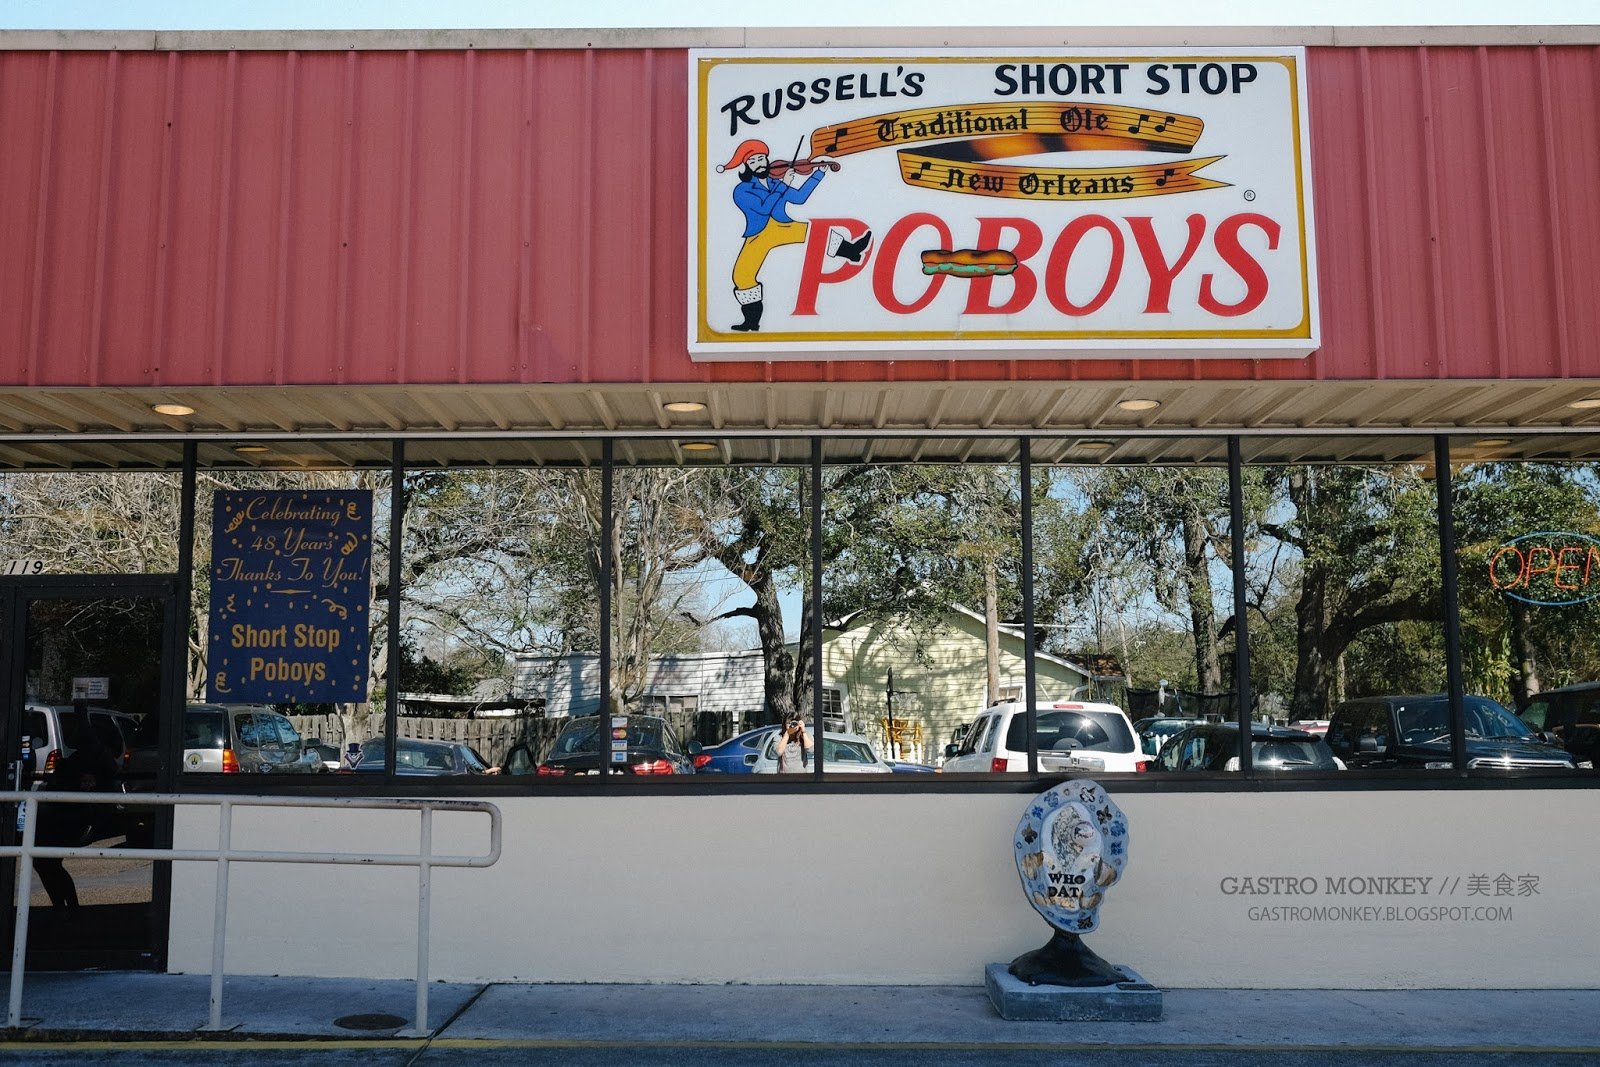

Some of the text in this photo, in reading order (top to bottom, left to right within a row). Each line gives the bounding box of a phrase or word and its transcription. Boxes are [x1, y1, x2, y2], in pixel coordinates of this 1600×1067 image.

[720, 63, 1259, 136] RUSSELL'S SHORT STOP
[873, 106, 1109, 142] Traditional Ole
[939, 168, 1135, 196] New Orleans
[245, 496, 341, 526] Celebrating
[251, 527, 333, 557] 48 Years
[9, 560, 43, 575] 119
[217, 557, 369, 588] Thanks To You!
[231, 623, 341, 653] Short Stop
[250, 656, 326, 686] Poboys
[1048, 873, 1086, 885] WHO
[1048, 886, 1079, 897] DAT
